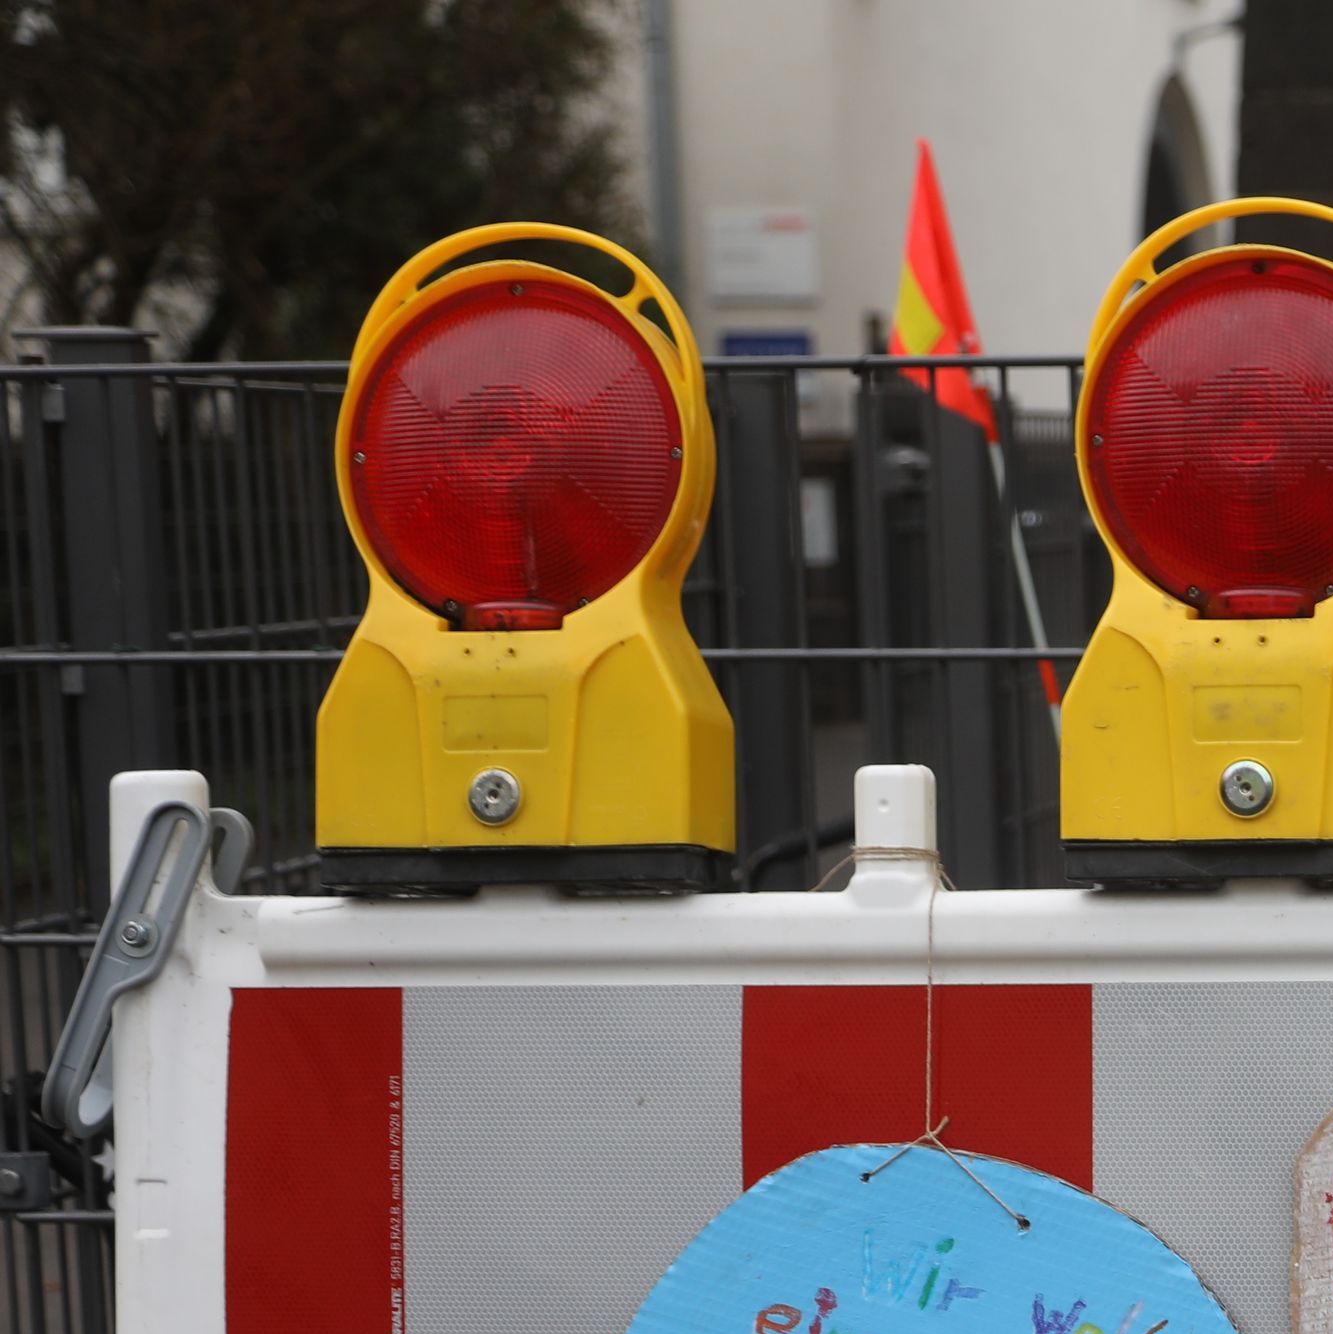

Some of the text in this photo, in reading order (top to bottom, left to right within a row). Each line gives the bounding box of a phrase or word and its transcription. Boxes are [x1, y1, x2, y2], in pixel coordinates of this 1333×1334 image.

[389, 1075, 401, 1096] 6171
[389, 1100, 401, 1110] &
[389, 1113, 401, 1146] 67520
[389, 1149, 401, 1170] DIN
[390, 1173, 401, 1200] nach
[861, 1228, 987, 1311] Wir
